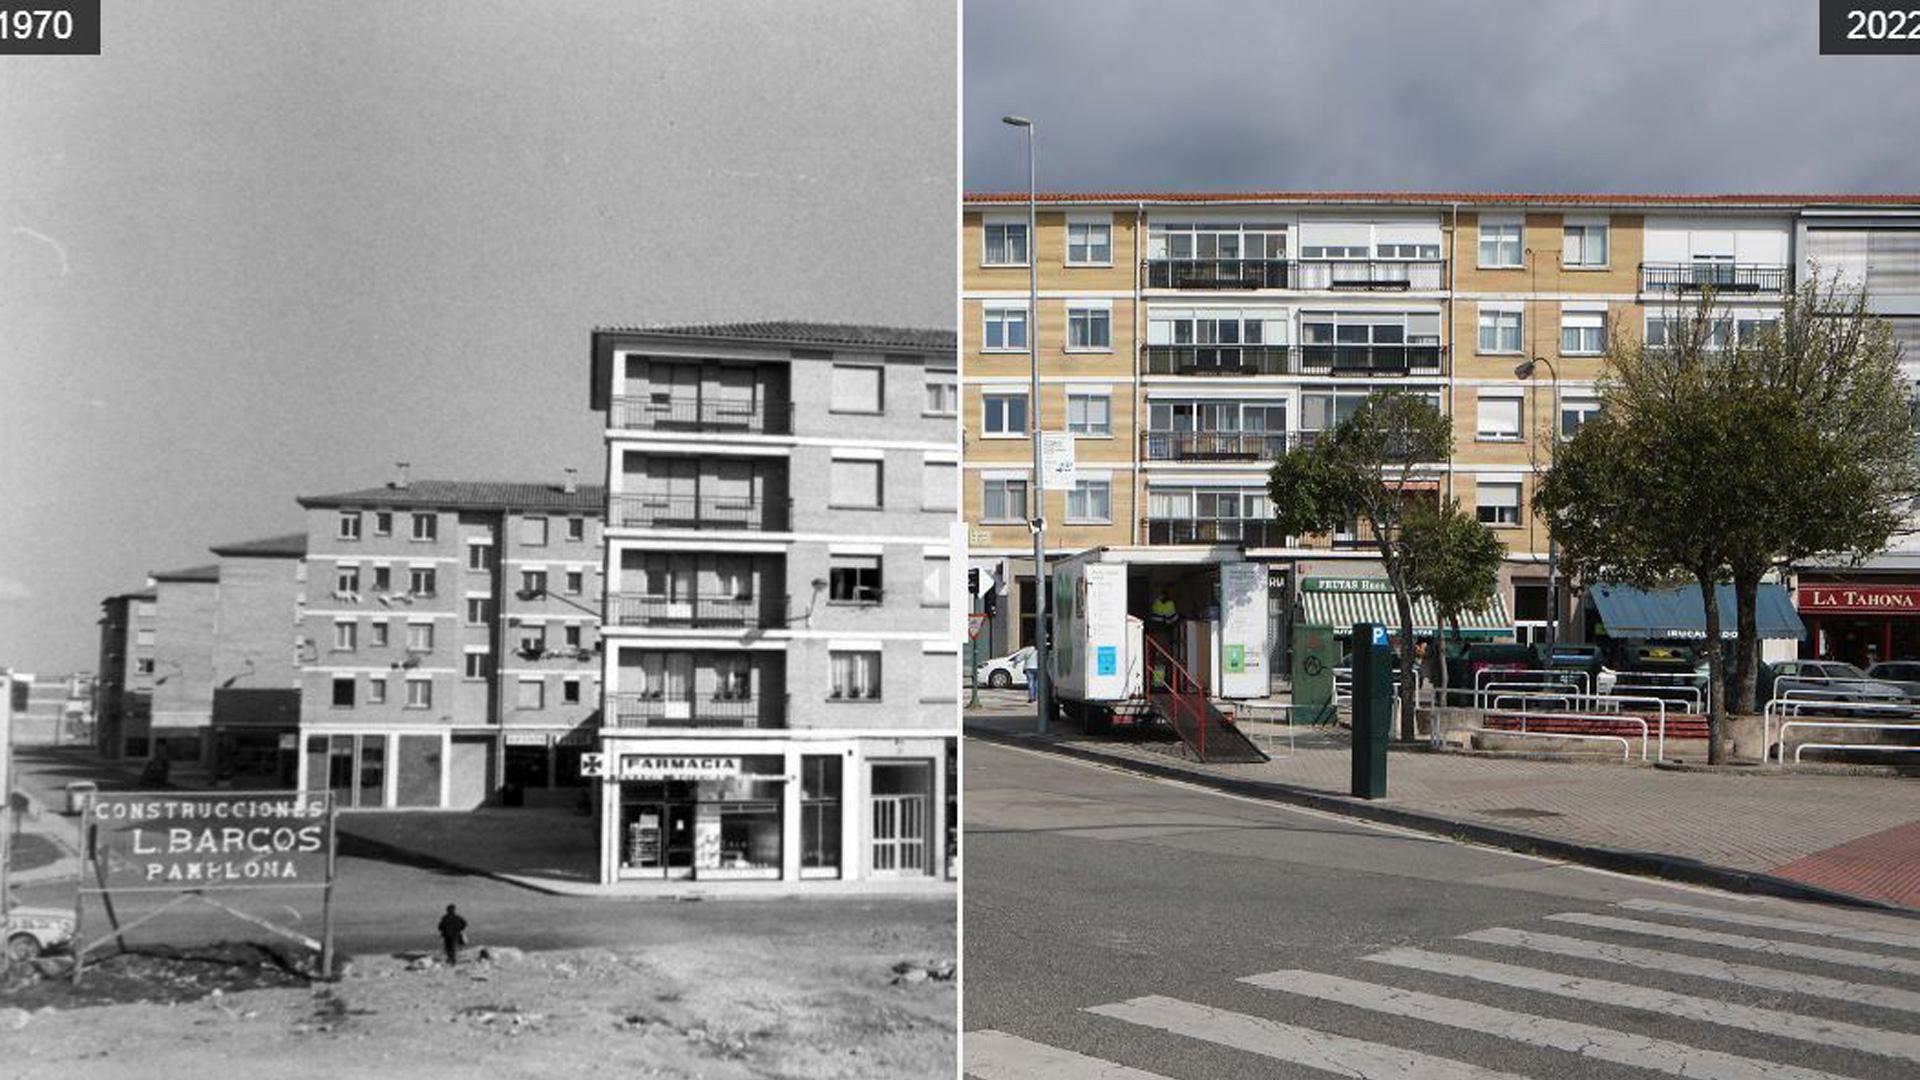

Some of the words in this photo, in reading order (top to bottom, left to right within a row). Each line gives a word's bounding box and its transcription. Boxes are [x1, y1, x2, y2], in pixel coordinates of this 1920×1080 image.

[1318, 580, 1358, 590] FRUTAS
[1843, 590, 1913, 607] TAHONA
[1373, 627, 1384, 645] P
[627, 758, 735, 769] FARMACIA
[94, 800, 325, 820] CONSTRUCCIONES
[145, 860, 298, 881] PAMPLONA
